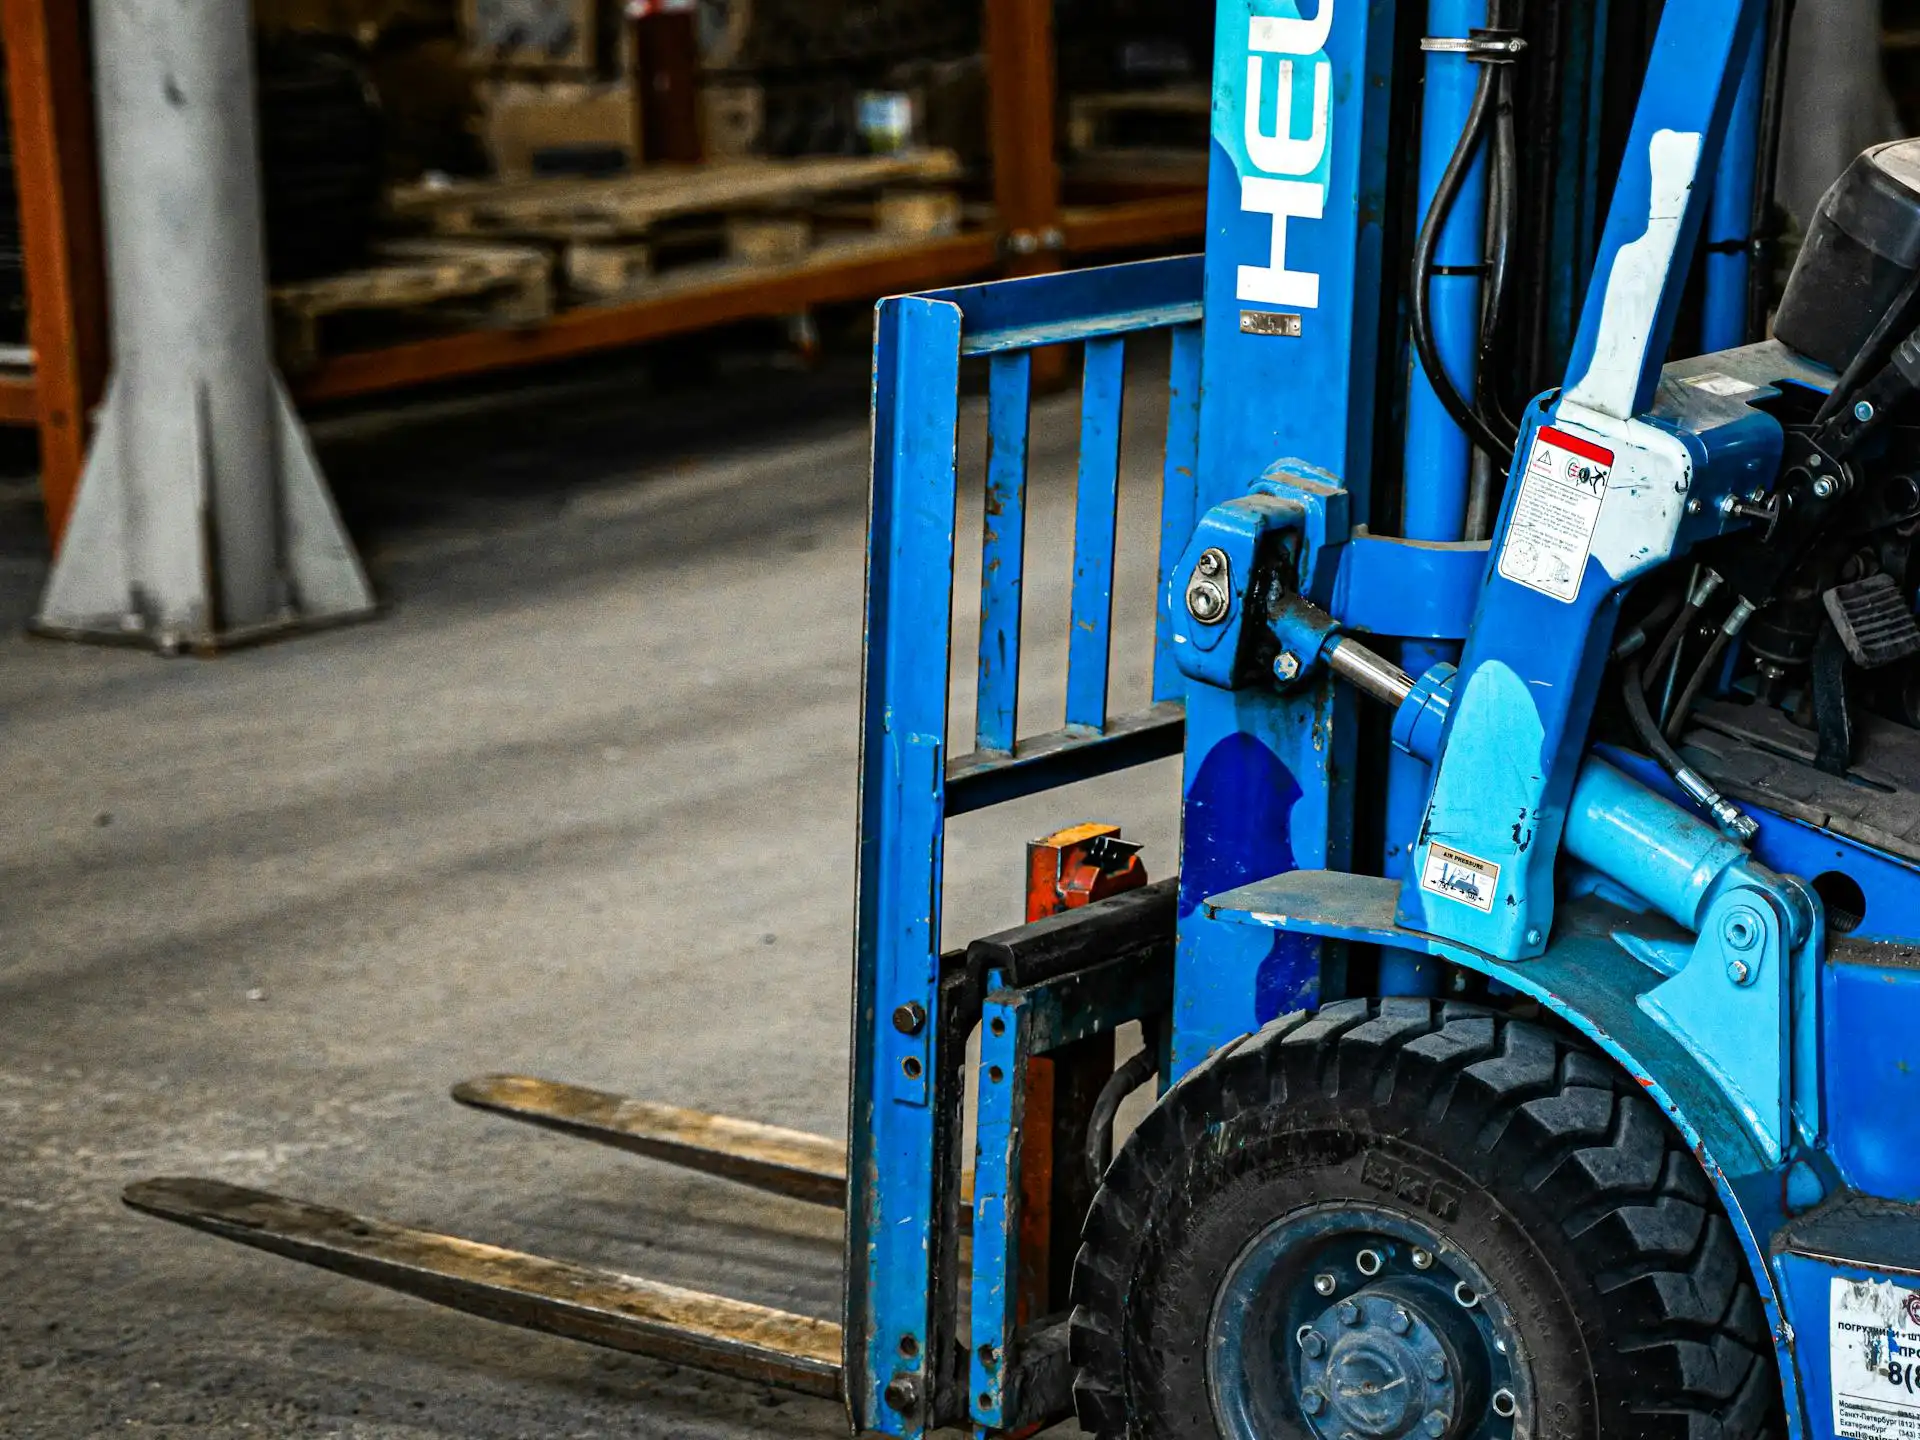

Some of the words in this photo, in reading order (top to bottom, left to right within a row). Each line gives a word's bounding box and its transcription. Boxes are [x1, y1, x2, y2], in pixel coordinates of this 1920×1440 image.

[1443, 851, 1454, 859] AIR
[1454, 854, 1484, 871] PRESSURE
[1840, 1409, 1897, 1426] Санкт-Петербург
[1840, 1419, 1887, 1433] Екатеринбург
